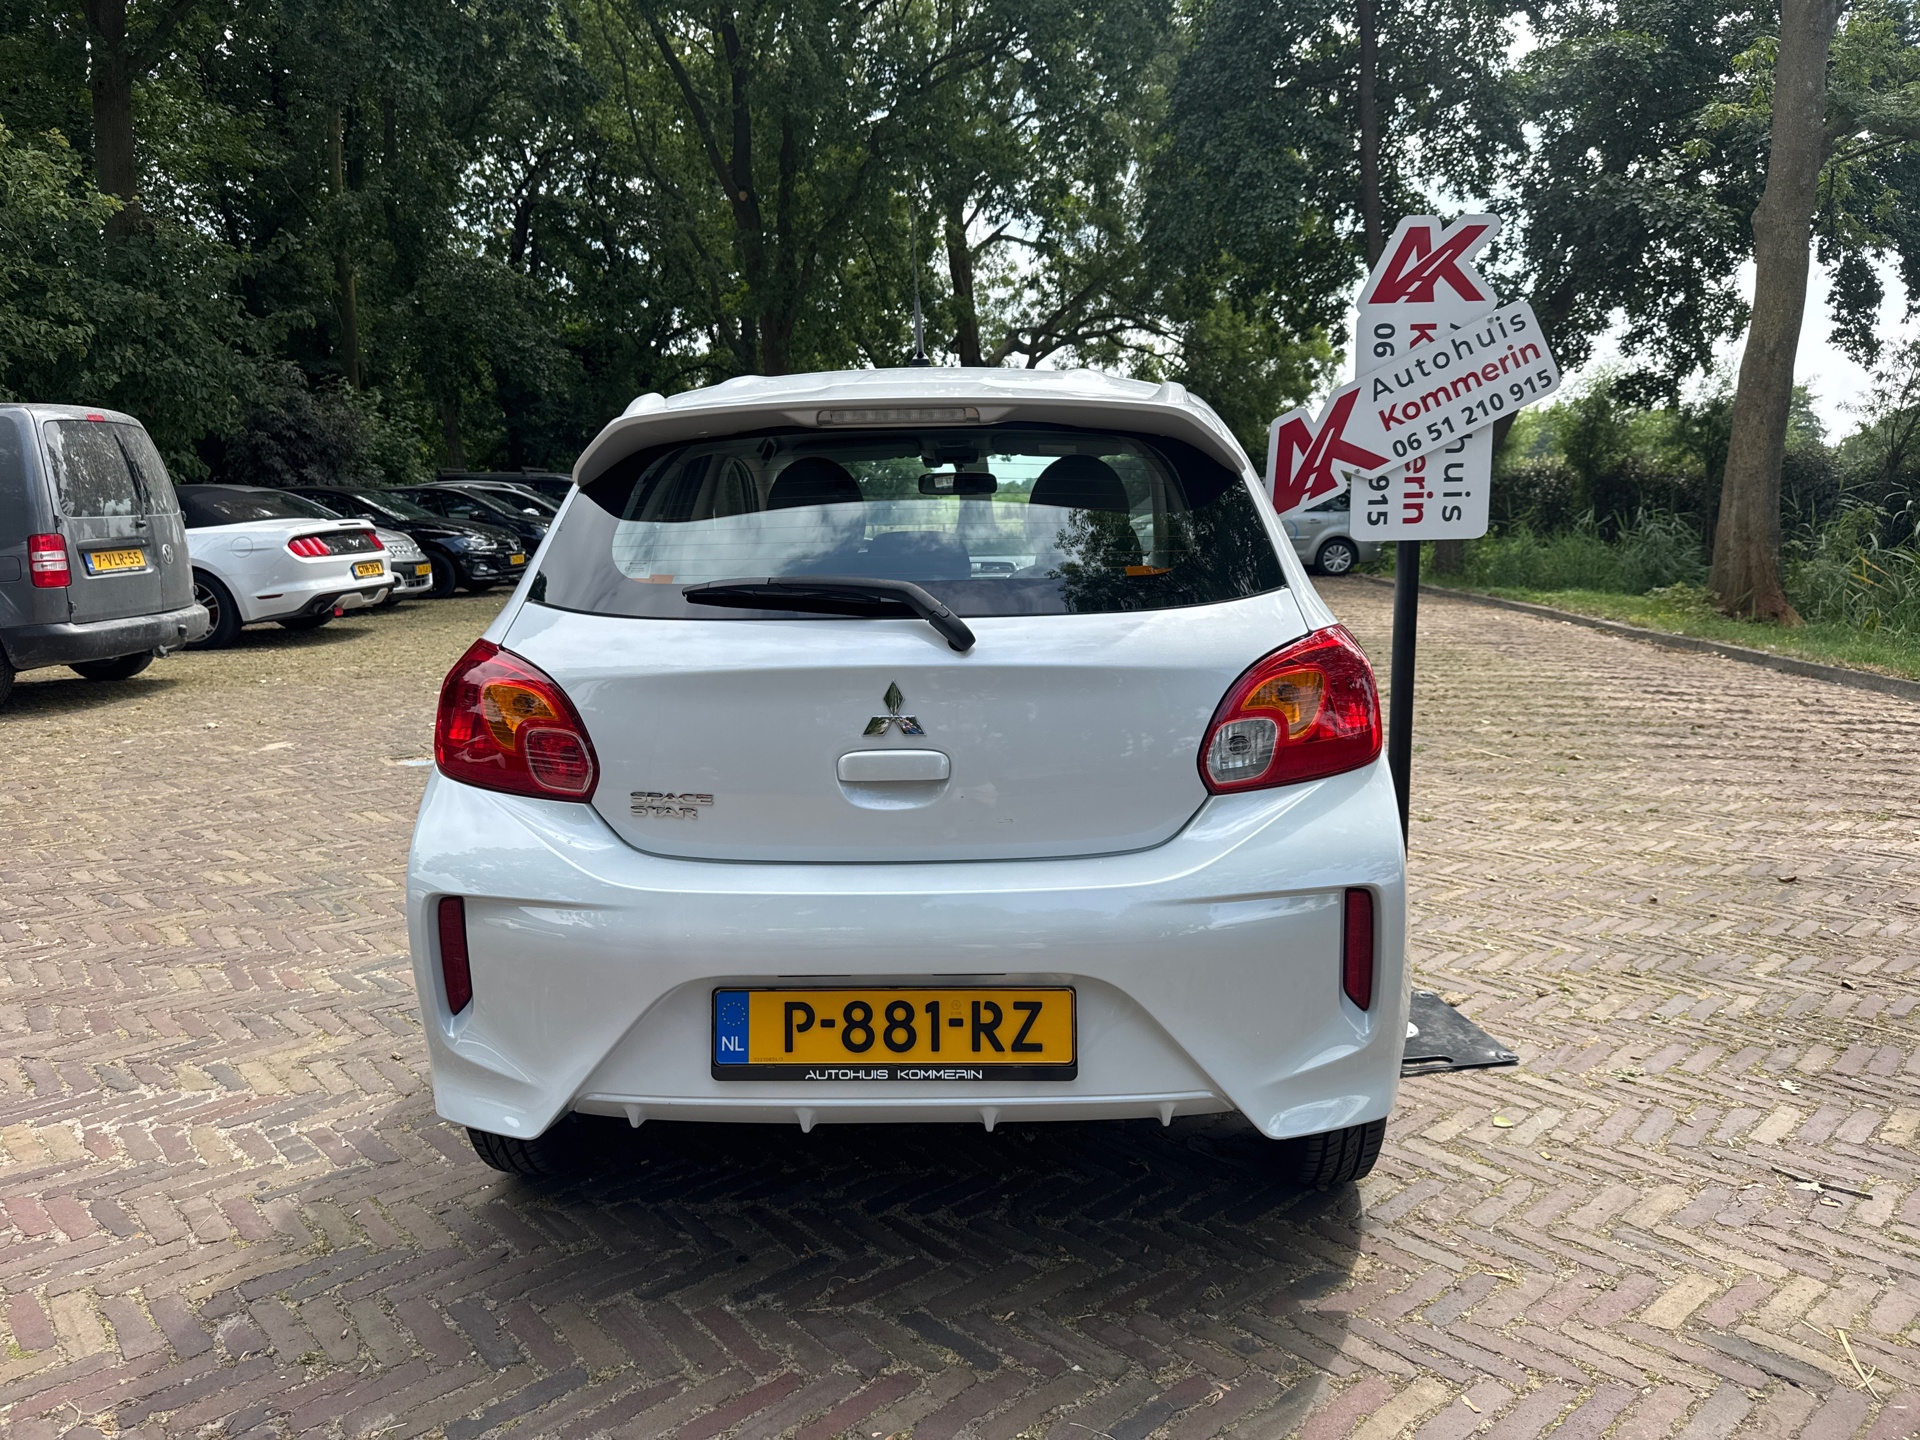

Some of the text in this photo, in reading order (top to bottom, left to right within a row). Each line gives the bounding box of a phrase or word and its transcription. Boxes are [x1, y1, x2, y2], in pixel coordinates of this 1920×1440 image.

[1372, 313, 1526, 402] Autohuis
[1378, 343, 1541, 432] Kommerin
[1367, 323, 1395, 526] 06 915
[1392, 369, 1553, 458] 06 51 210 915
[95, 551, 141, 568] 7-VLR-55
[630, 791, 714, 806] SPACE
[630, 805, 699, 820] STAR
[721, 1036, 745, 1052] NL
[784, 1000, 1044, 1053] P-881-RZ
[804, 1069, 983, 1080] AUTOHUIS KOMMERIN
